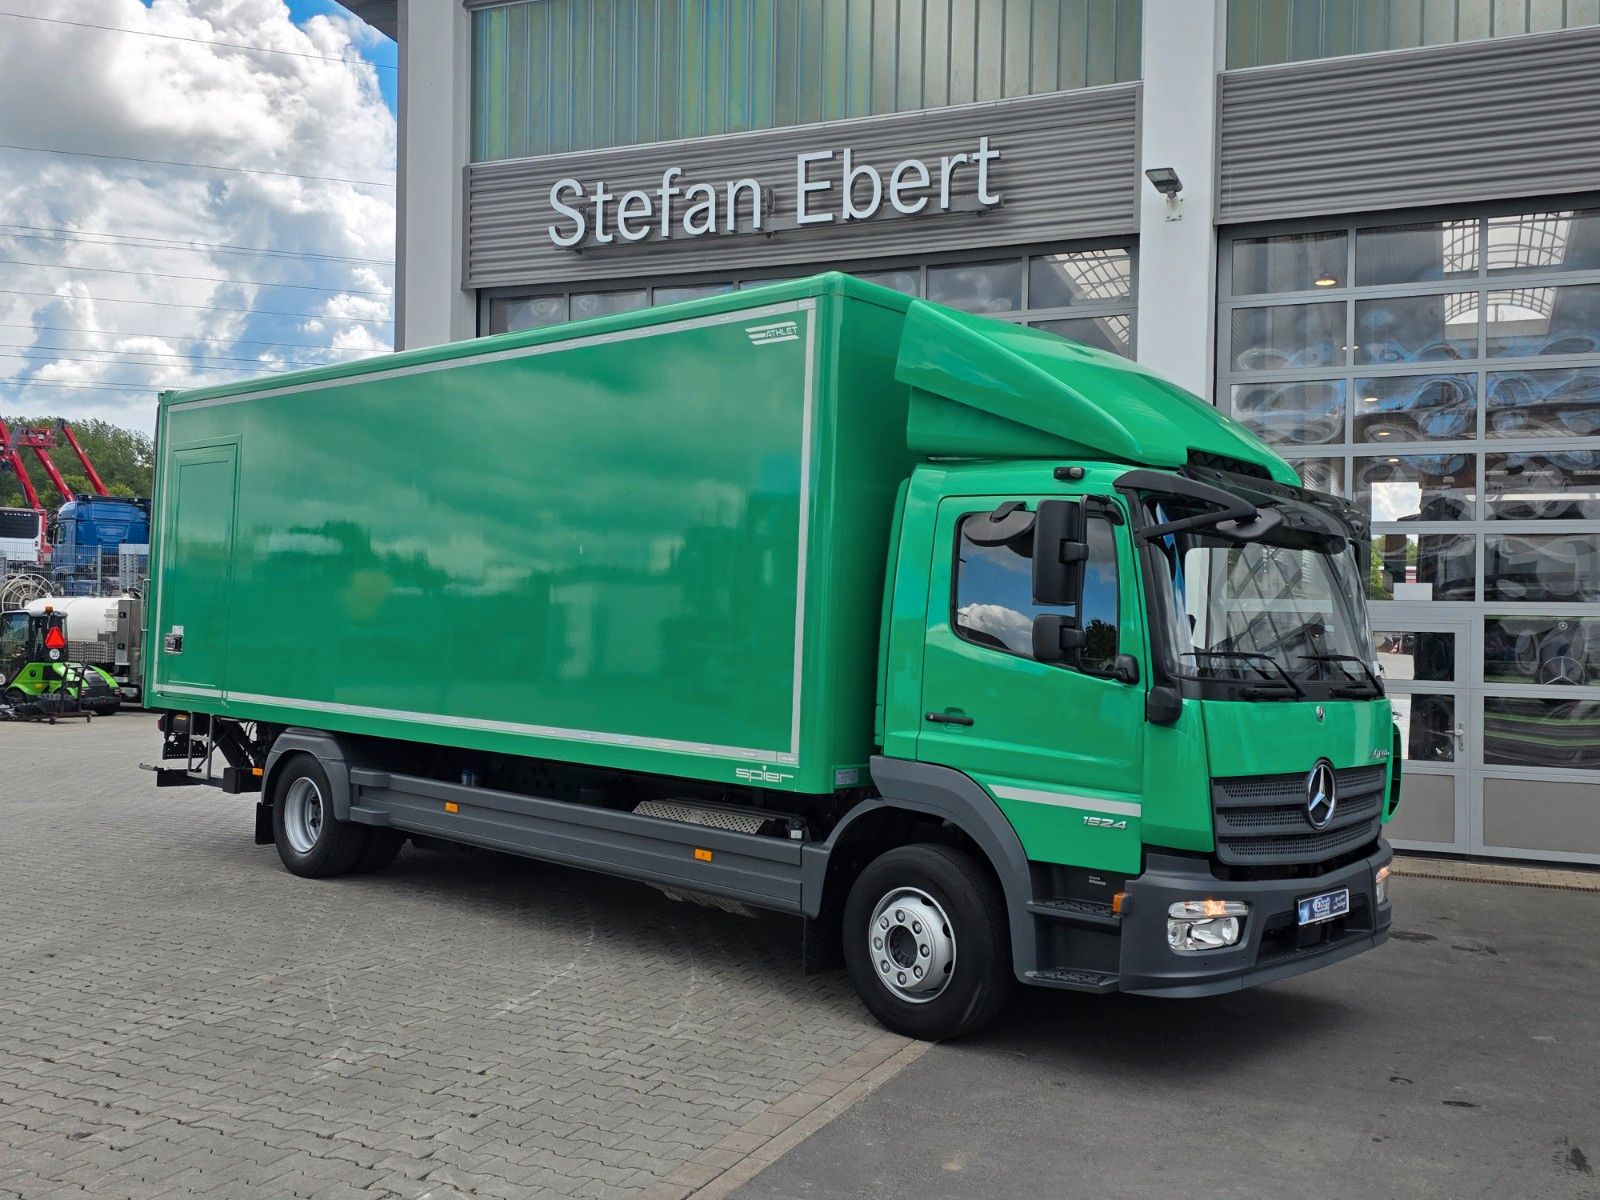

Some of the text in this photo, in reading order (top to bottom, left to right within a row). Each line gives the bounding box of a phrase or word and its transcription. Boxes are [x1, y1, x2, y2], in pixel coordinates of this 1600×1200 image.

[548, 136, 1001, 247] Stefan Ebert
[765, 326, 798, 338] ATHLET
[736, 765, 794, 783] spier
[1083, 816, 1127, 829] 1524
